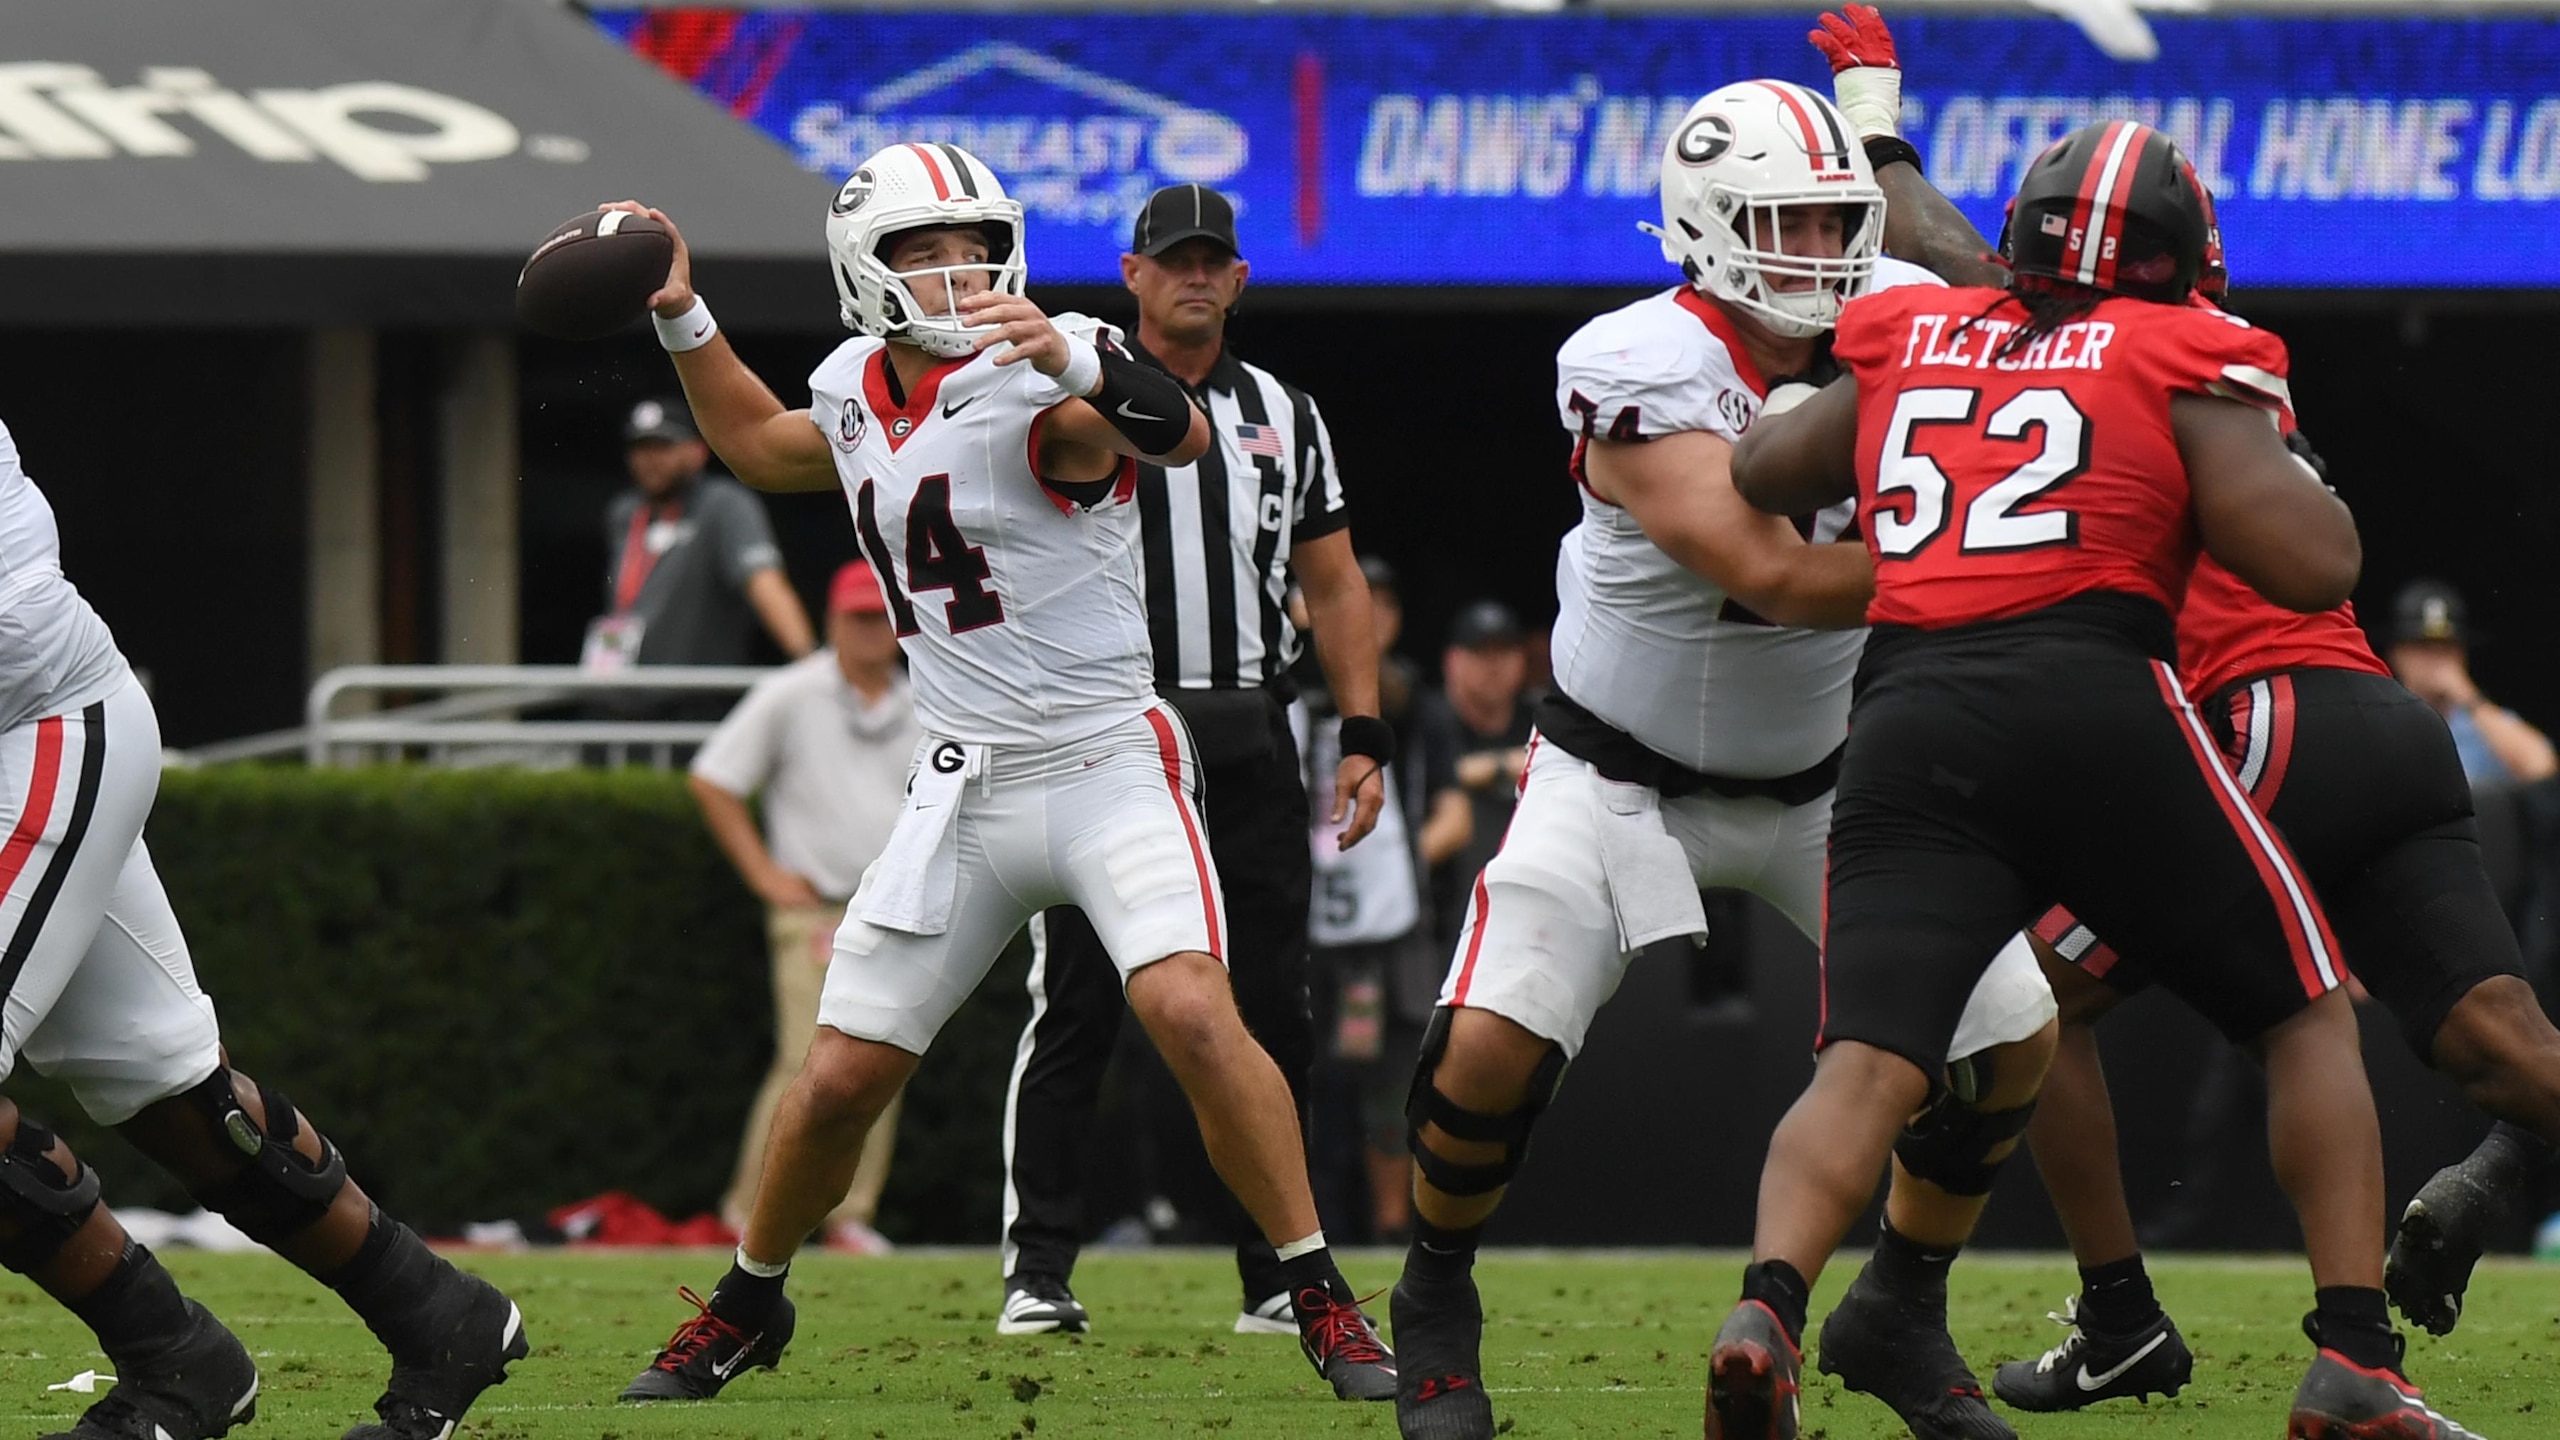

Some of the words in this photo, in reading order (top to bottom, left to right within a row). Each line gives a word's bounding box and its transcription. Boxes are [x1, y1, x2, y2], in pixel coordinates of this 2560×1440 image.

[2251, 97, 2472, 200] HOME
[1260, 493, 1282, 532] C
[1875, 386, 2092, 562] 52
[857, 473, 1005, 638] 14
[931, 741, 966, 774] G
